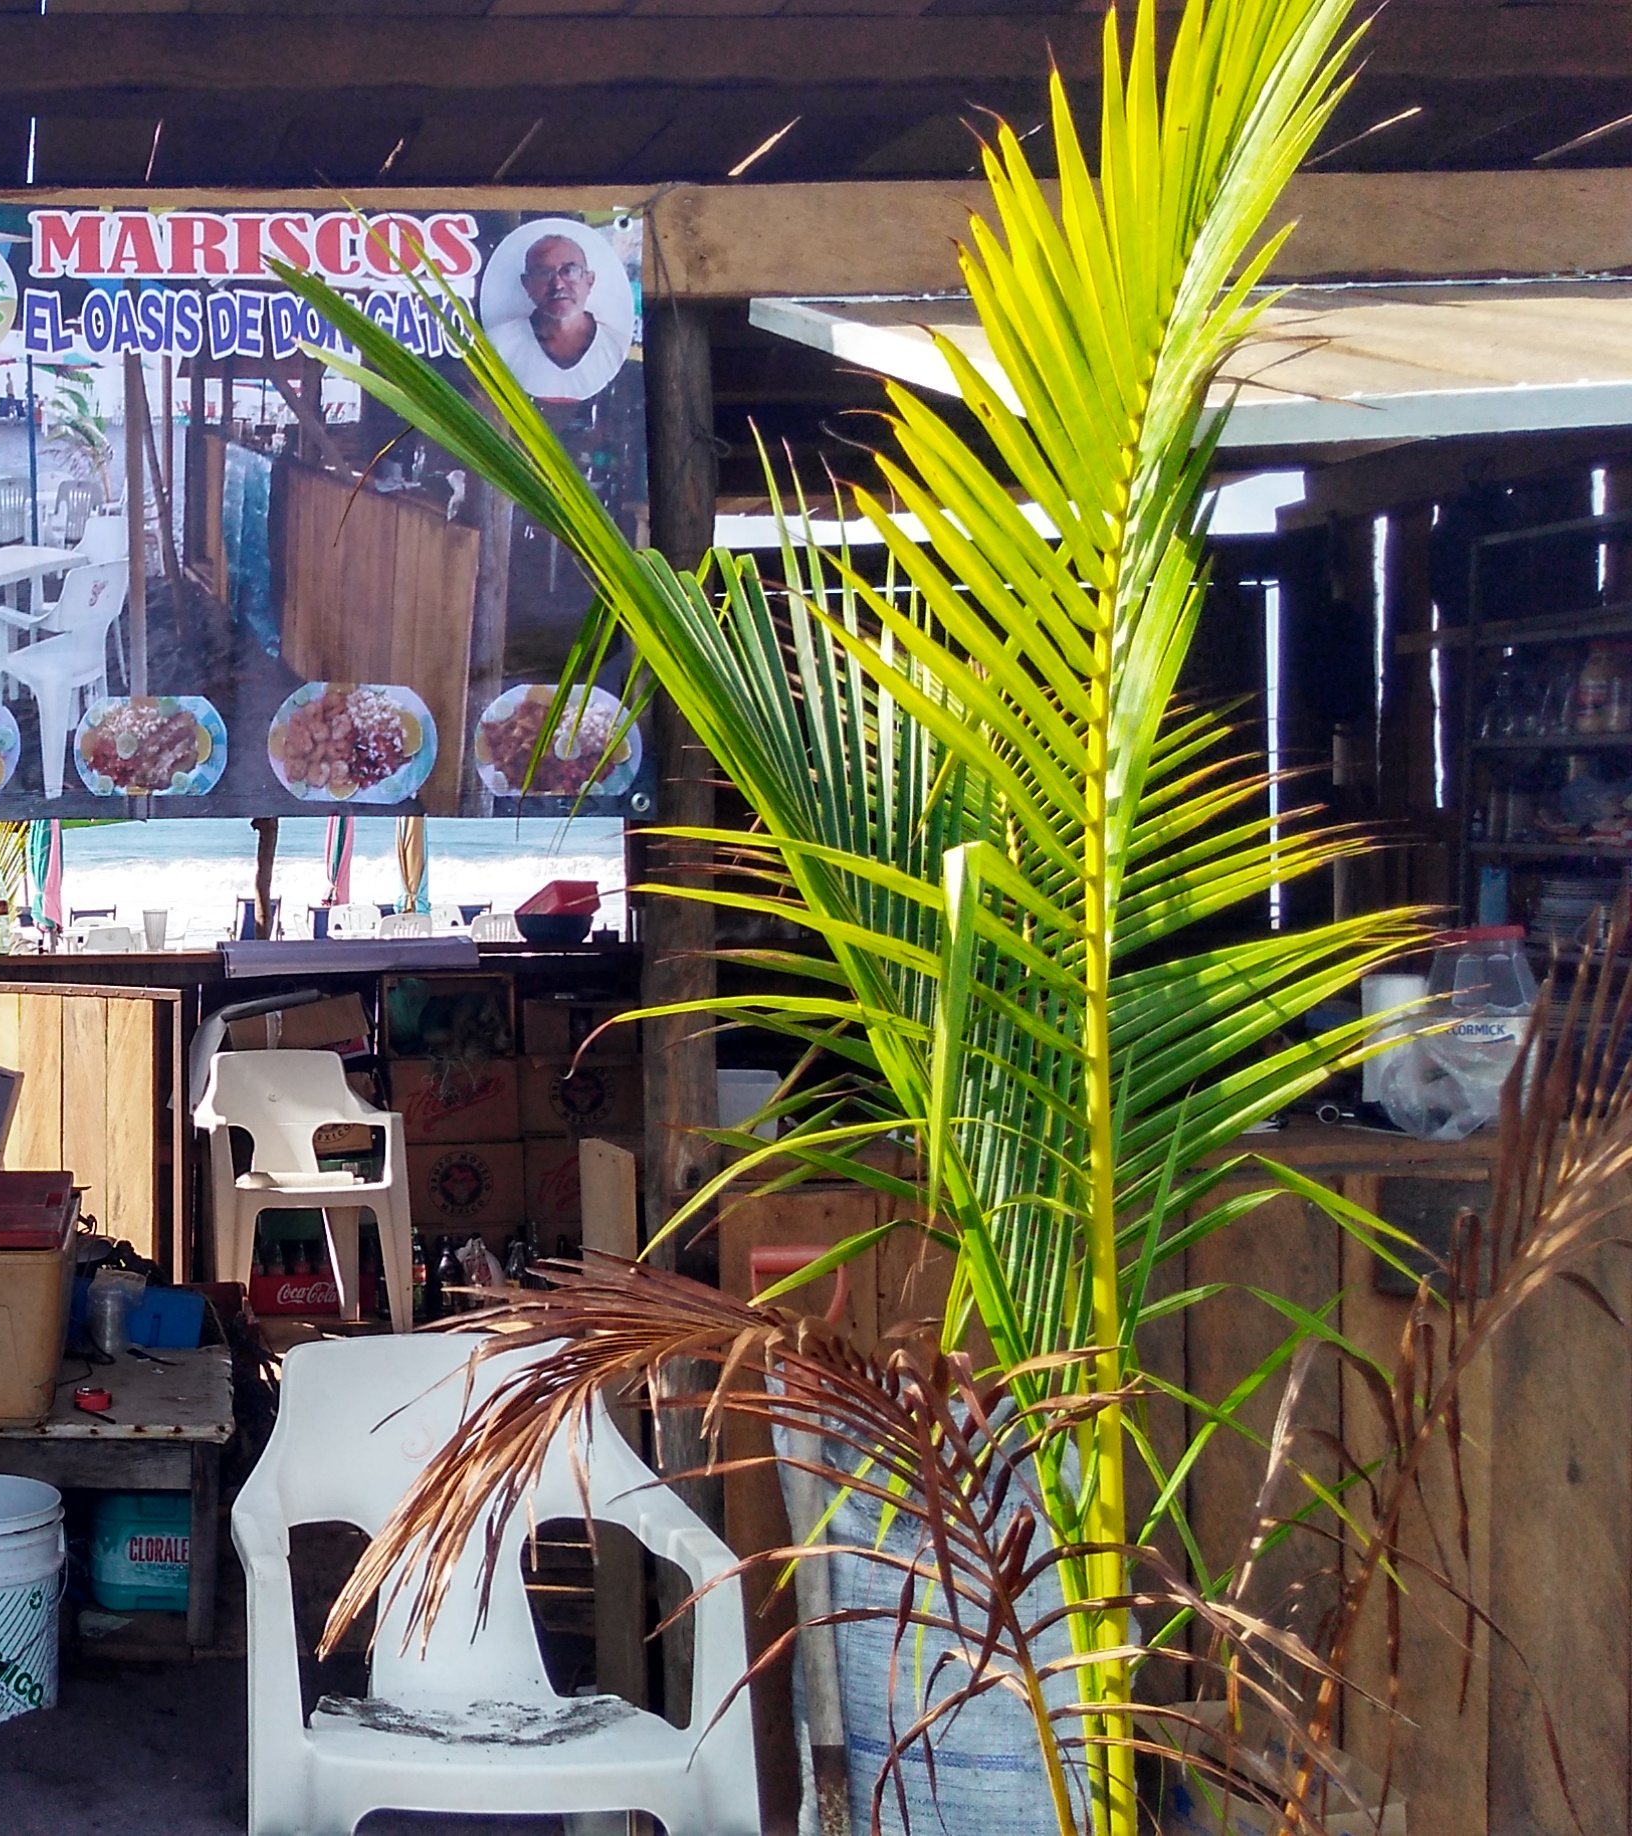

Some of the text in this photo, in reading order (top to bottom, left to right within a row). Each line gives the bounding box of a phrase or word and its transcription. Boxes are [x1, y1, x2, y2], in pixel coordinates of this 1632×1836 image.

[32, 211, 478, 279] MARISCOS
[24, 290, 73, 354] EL
[82, 290, 201, 355] OASIS
[209, 291, 265, 358] DE
[365, 291, 475, 358] GATO
[316, 1124, 352, 1141] EXICO
[276, 1281, 340, 1305] Coca-Cola
[129, 1536, 188, 1563] CLORALE
